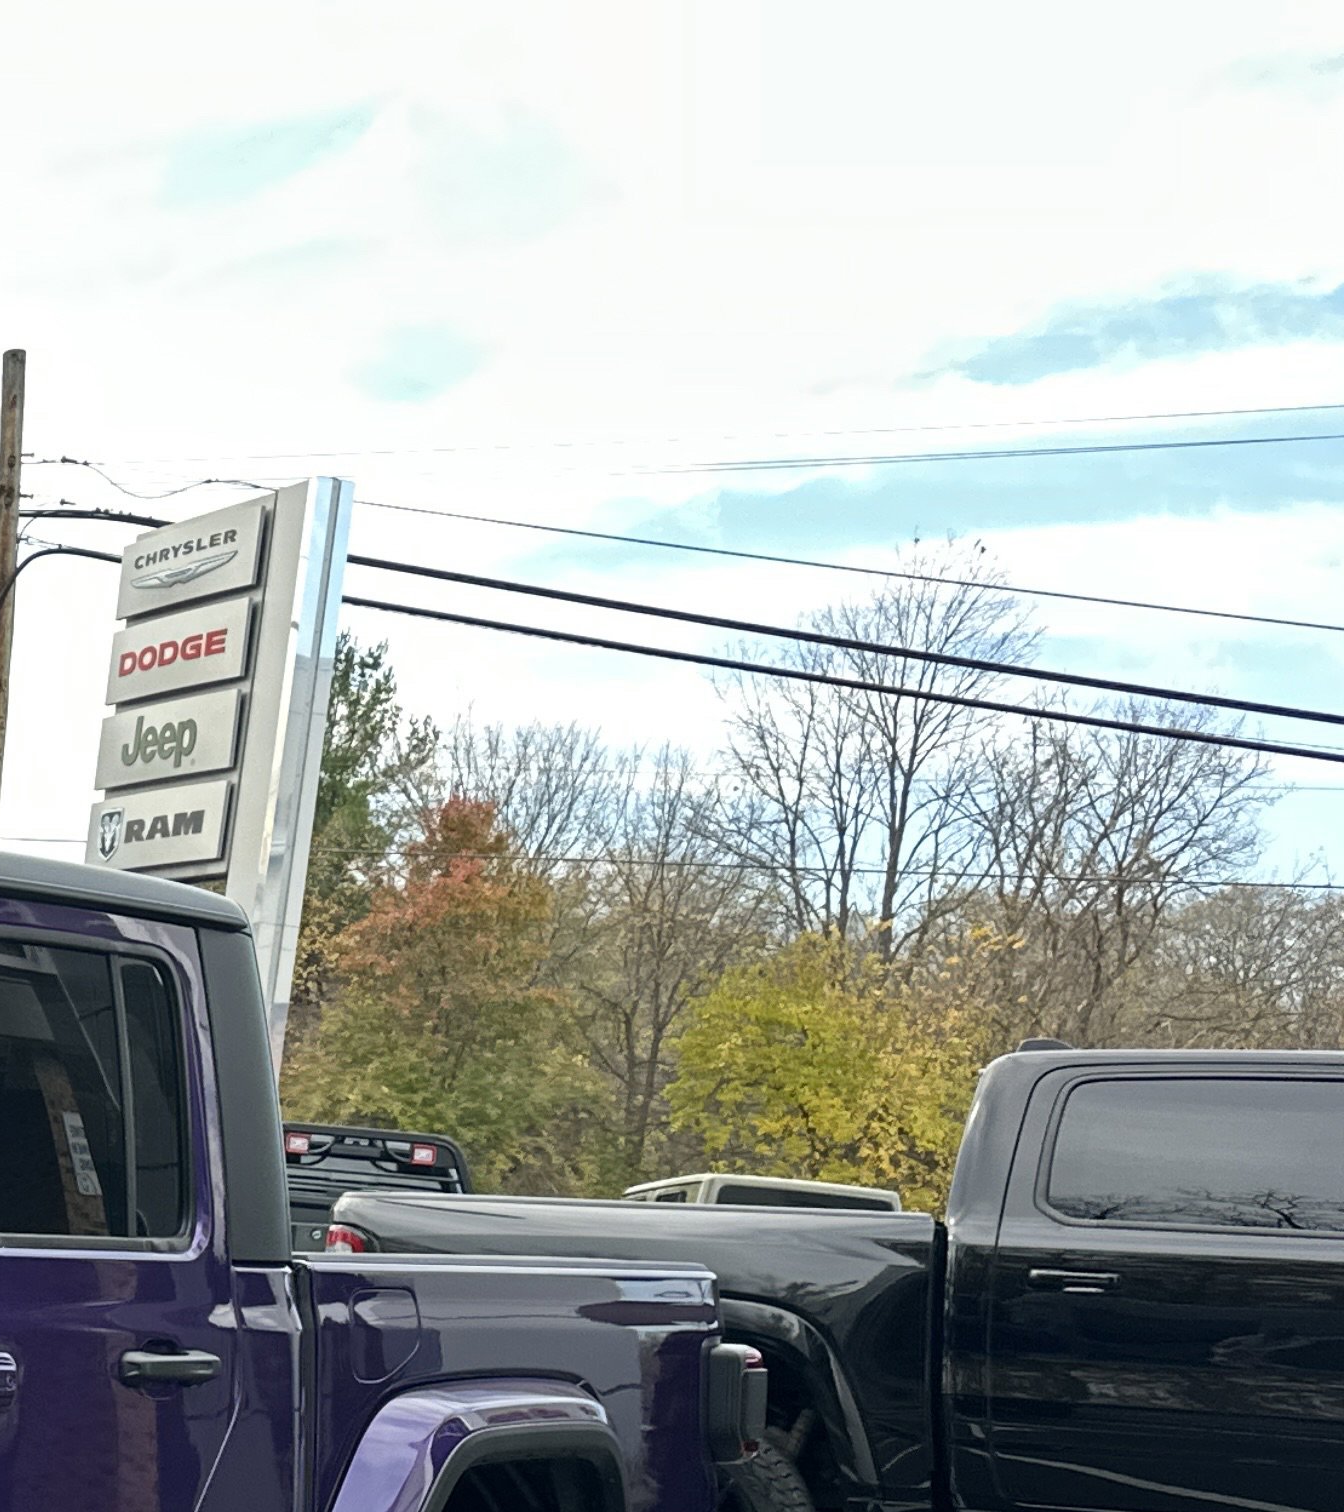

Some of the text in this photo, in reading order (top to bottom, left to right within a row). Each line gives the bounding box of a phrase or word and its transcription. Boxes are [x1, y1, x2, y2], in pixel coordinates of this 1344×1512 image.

[134, 528, 238, 571] CHRYSLER
[118, 628, 228, 677] DODGE
[121, 715, 197, 768] Jeep
[123, 809, 205, 844] RAM
